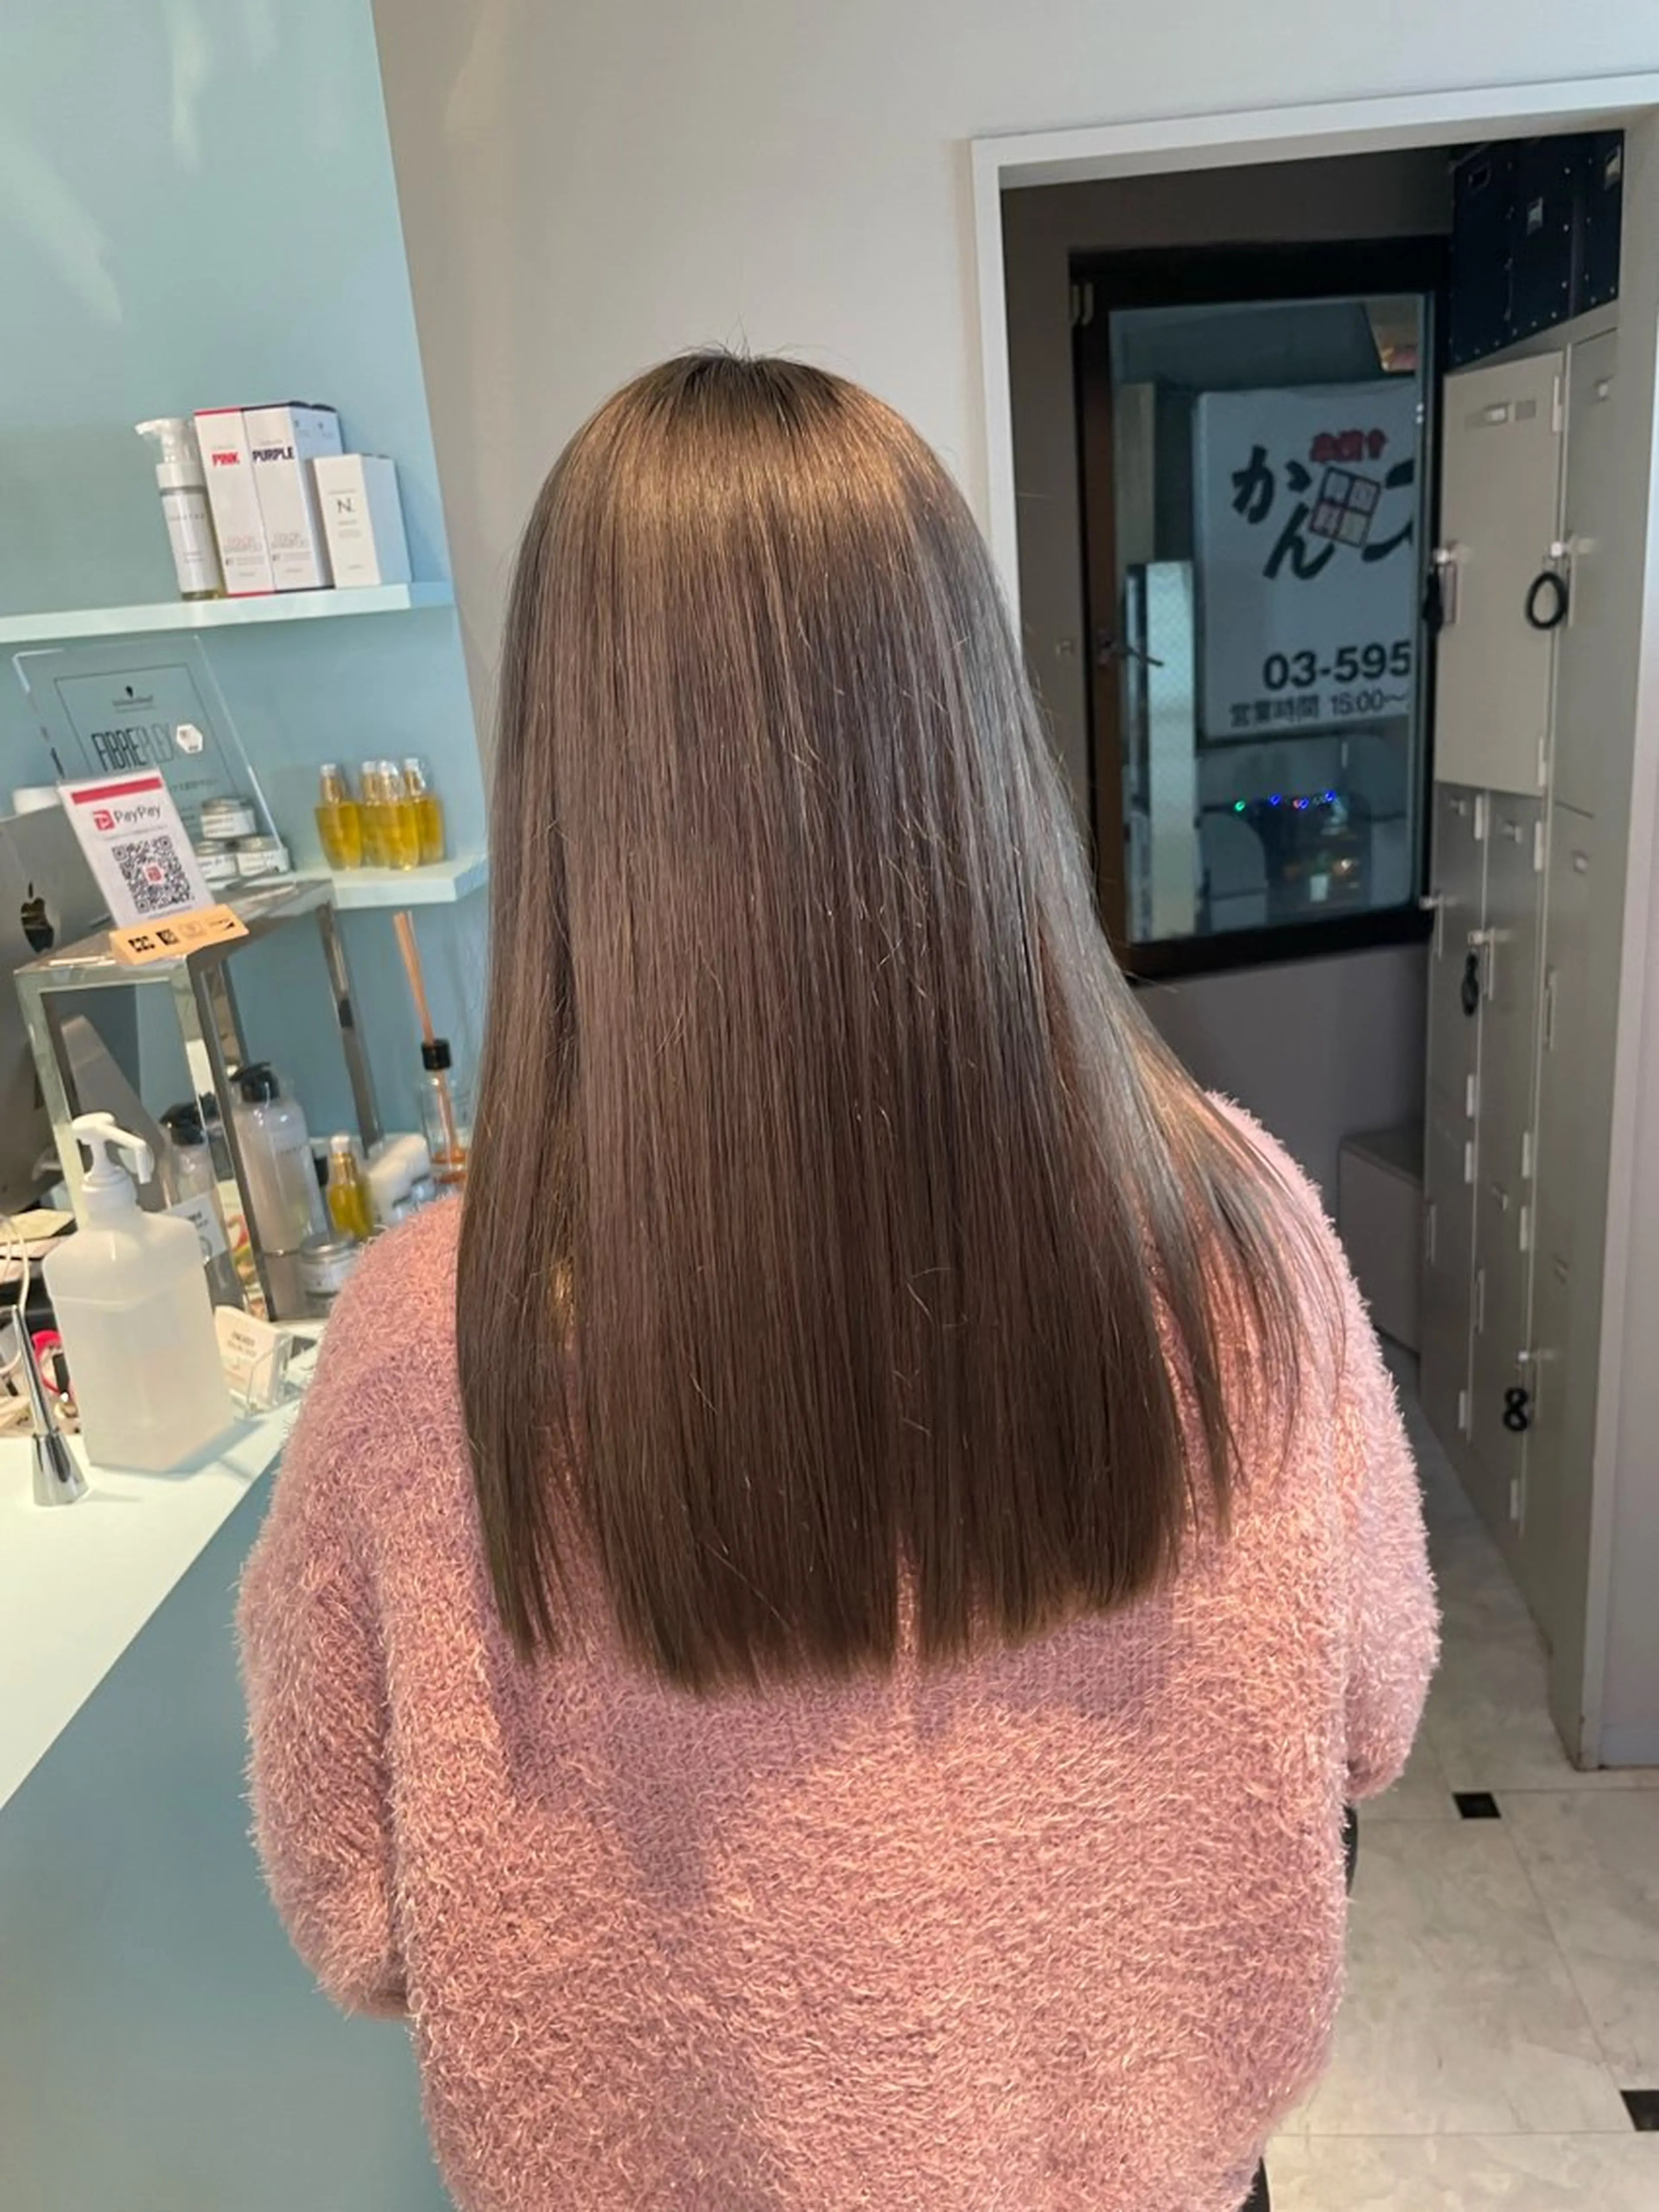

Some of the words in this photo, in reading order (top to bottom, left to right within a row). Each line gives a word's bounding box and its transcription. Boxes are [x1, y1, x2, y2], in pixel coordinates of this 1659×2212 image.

[212, 451, 240, 467] PINK
[252, 447, 294, 462] PURPLE
[1230, 694, 1319, 728] 営業時間
[113, 805, 161, 823] PayPay
